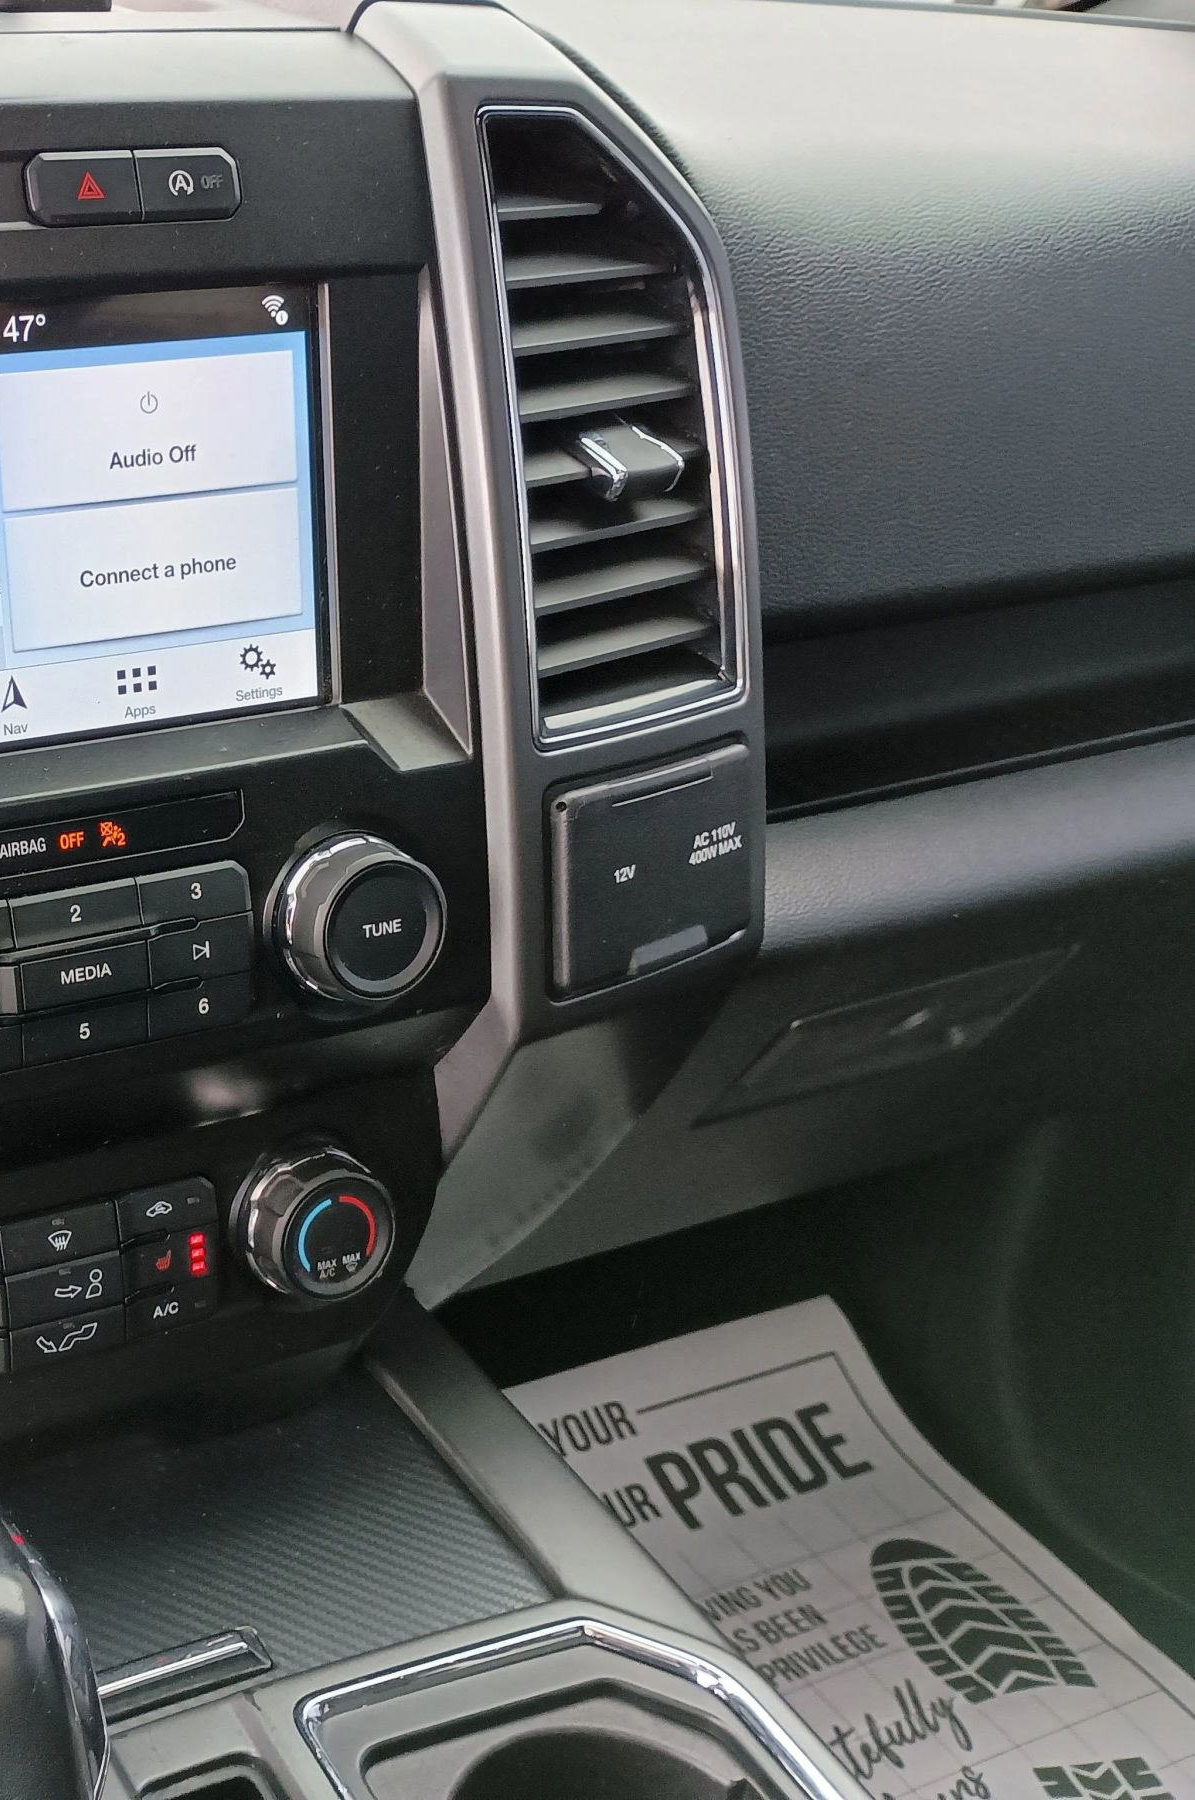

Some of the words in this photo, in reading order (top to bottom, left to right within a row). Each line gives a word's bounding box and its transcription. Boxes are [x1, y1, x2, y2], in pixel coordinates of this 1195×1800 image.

[201, 174, 224, 189] OFF
[2, 313, 46, 343] 47°
[109, 448, 164, 470] Audio
[168, 443, 197, 464] Off
[79, 562, 159, 588] Connect
[163, 564, 175, 580] a
[179, 556, 237, 579] phone
[235, 685, 283, 703] Settings
[124, 704, 157, 719] Apps
[3, 723, 29, 737] Nav
[0, 837, 47, 860] AIRBAG
[59, 831, 85, 852] OFF
[693, 831, 710, 850] AC
[711, 821, 736, 842] 110V
[688, 844, 718, 866] 400W
[718, 834, 743, 856] MAX
[613, 864, 636, 884] 12V
[190, 882, 202, 901] 3
[70, 905, 82, 923] 2
[362, 918, 403, 939] TUNE
[60, 962, 112, 986] MEDIA
[197, 998, 210, 1015] 6
[79, 1022, 91, 1041] 5
[317, 1258, 337, 1272] MAX
[342, 1251, 361, 1265] MAX
[153, 1300, 180, 1320] A/C
[538, 1400, 639, 1458] YOUR
[644, 1401, 875, 1531] PRIDE
[753, 1567, 814, 1601] YOU
[753, 1603, 829, 1646] BEEN
[755, 1623, 889, 1690] PRIVILEGE
